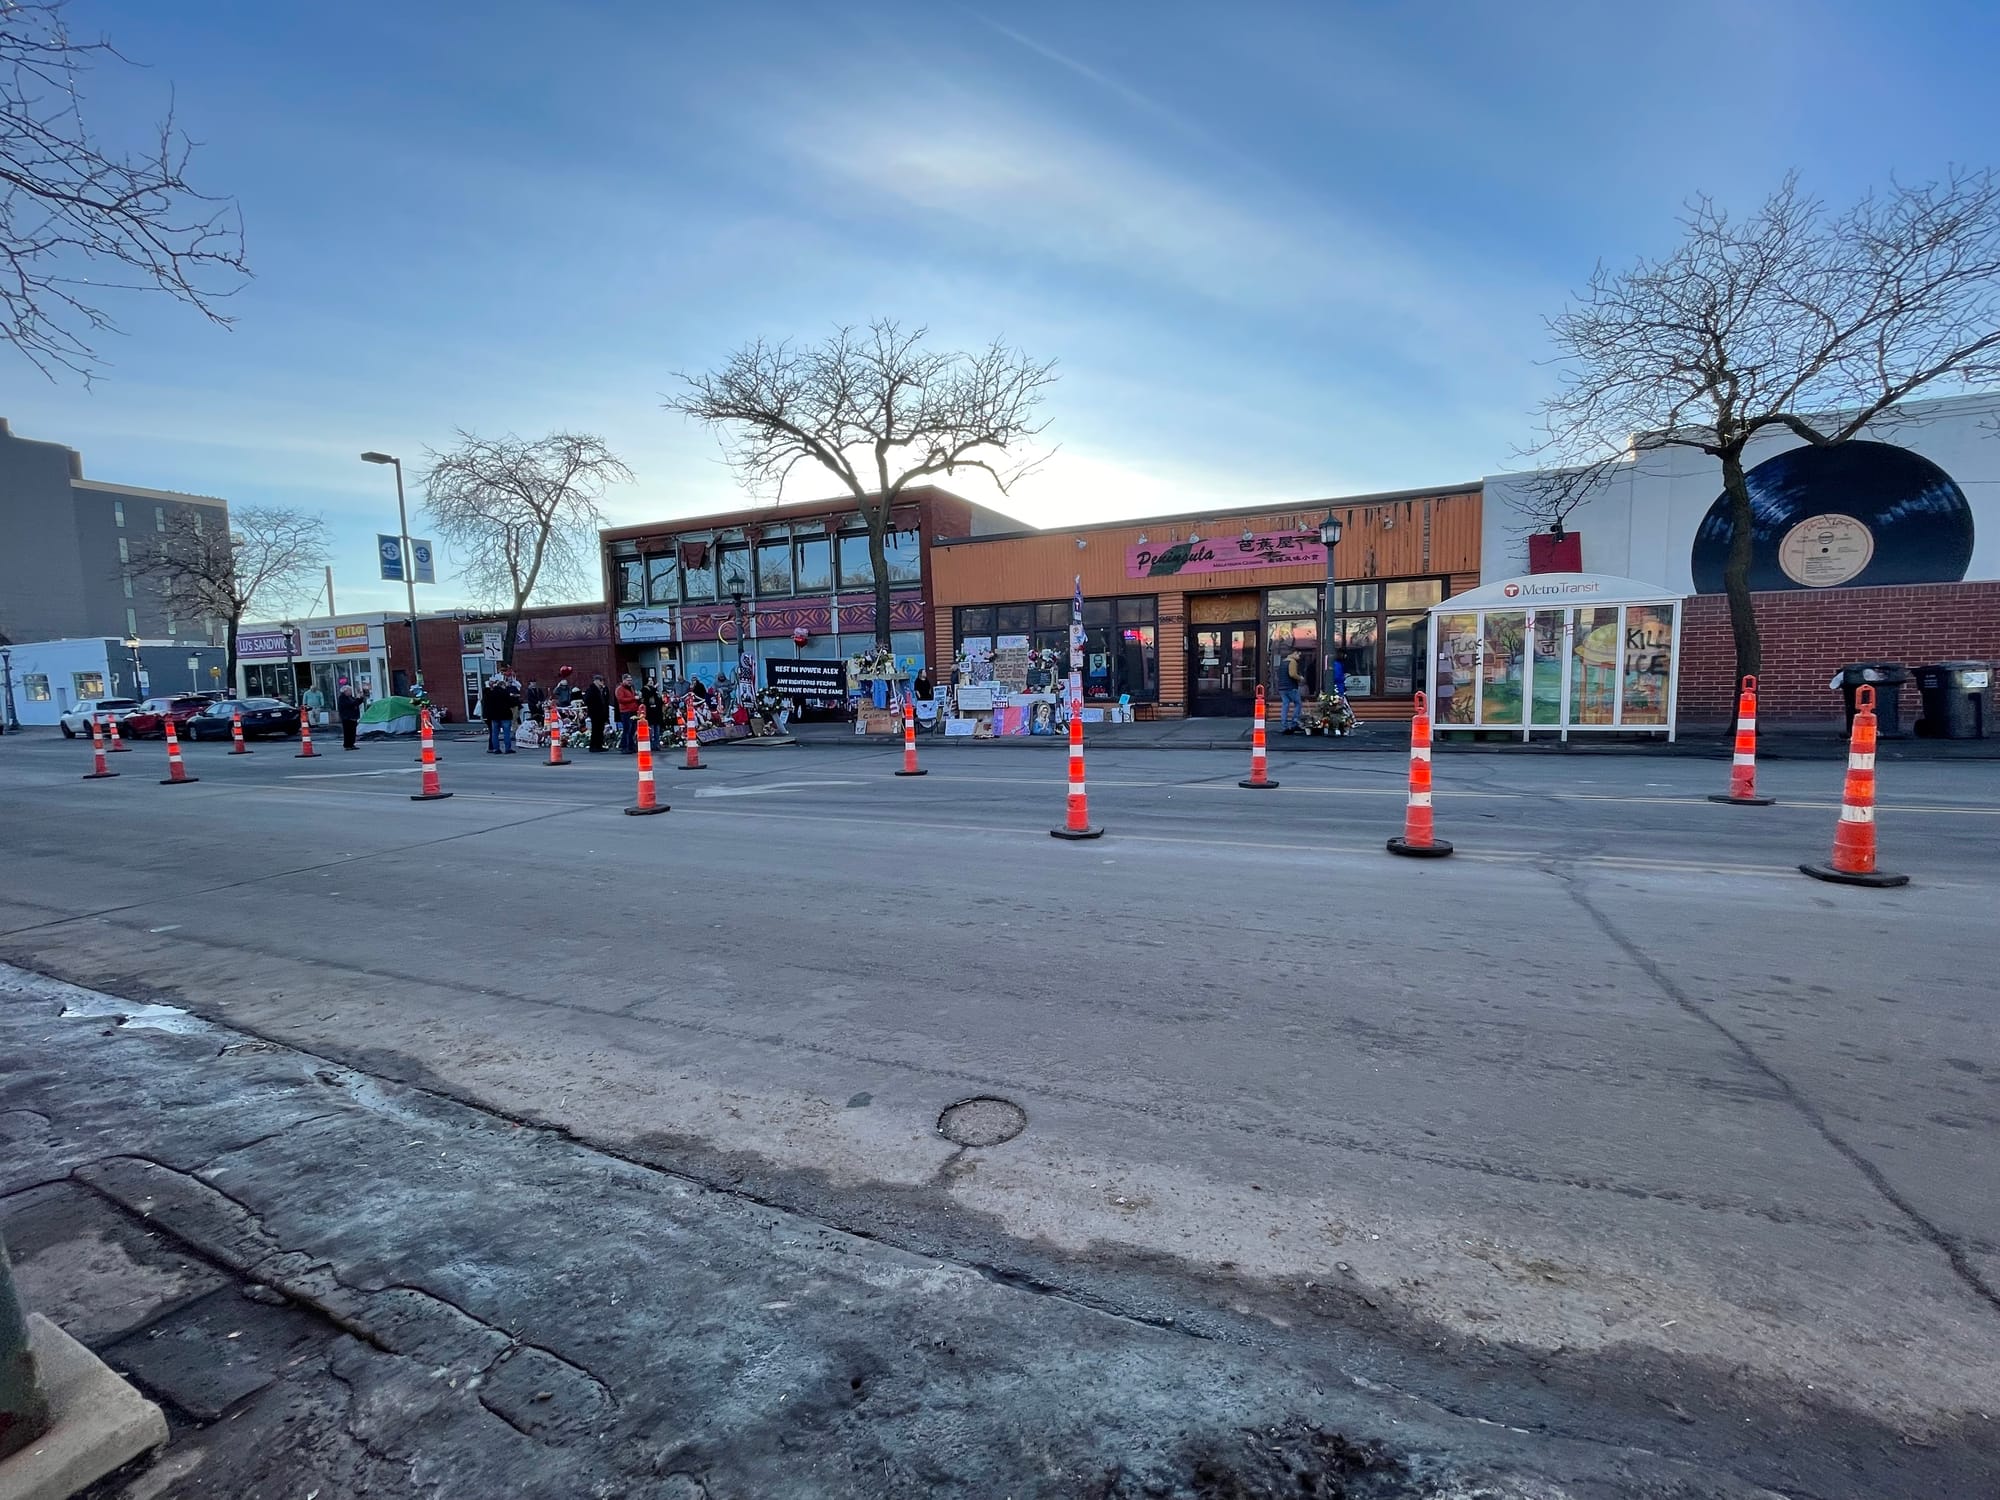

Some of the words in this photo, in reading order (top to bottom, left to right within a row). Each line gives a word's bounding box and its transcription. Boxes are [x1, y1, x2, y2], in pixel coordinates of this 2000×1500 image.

[1136, 546, 1215, 570] Peninsula
[1451, 637, 1482, 653] FUCK
[1626, 628, 1671, 649] KILL
[775, 665, 790, 673] REST
[799, 666, 821, 674] POWER
[822, 667, 839, 675] ALEX
[1449, 653, 1482, 670] ICE
[1626, 654, 1670, 676] ICE
